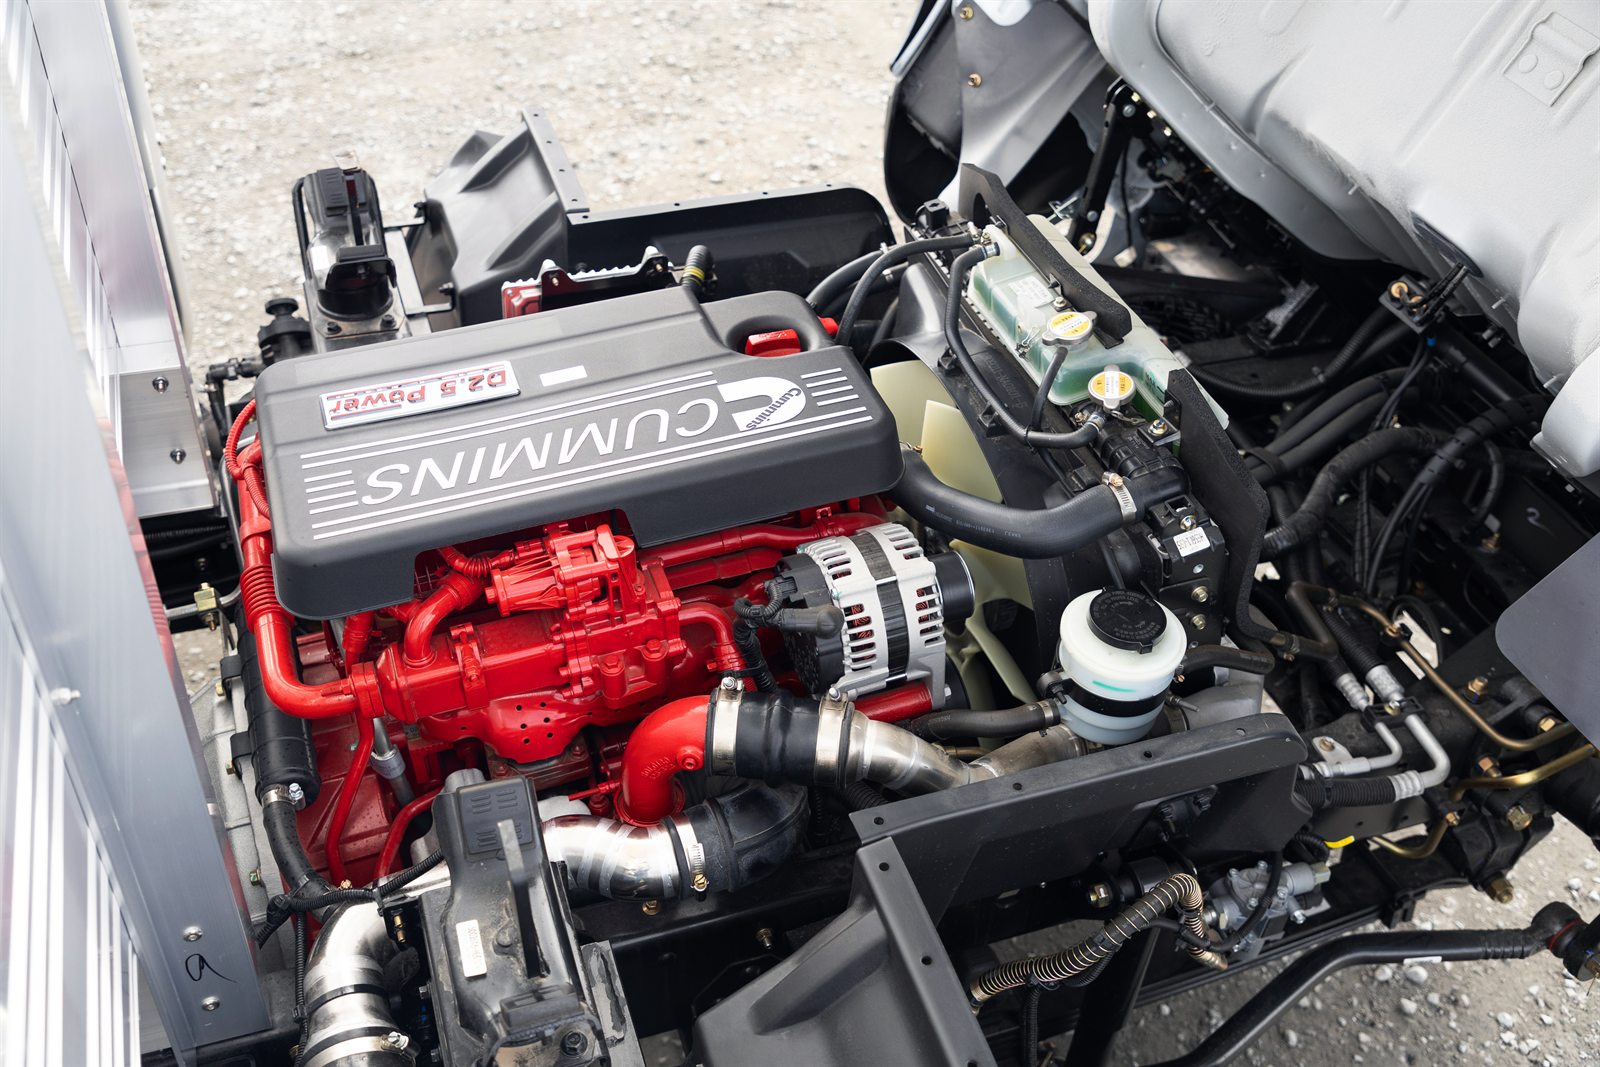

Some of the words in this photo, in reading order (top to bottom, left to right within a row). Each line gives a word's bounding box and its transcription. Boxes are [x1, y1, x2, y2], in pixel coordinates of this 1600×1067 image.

[329, 386, 426, 415] Power
[440, 370, 506, 398] D2.5
[745, 387, 802, 431] Cummins
[361, 398, 718, 506] CUMMINS
